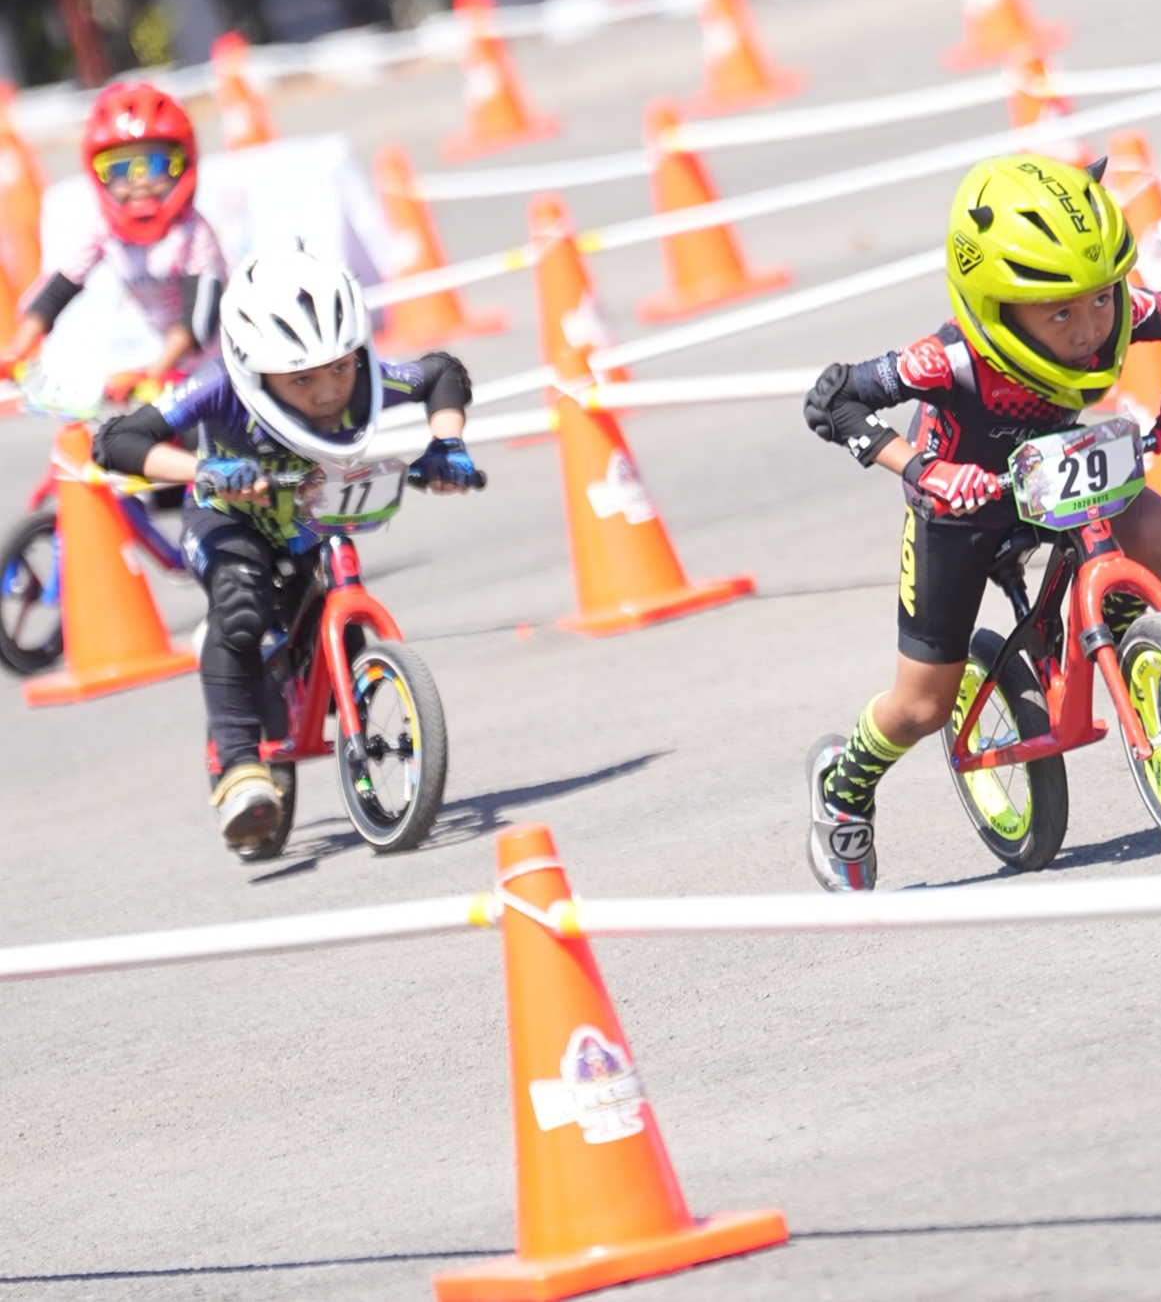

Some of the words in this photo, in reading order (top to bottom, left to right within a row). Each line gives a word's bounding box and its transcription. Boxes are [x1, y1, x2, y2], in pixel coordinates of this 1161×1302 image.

[1015, 161, 1092, 234] RACING
[1058, 449, 1109, 501] 29
[339, 481, 374, 516] 11
[1072, 498, 1091, 511] 2020
[836, 828, 871, 853] 72
